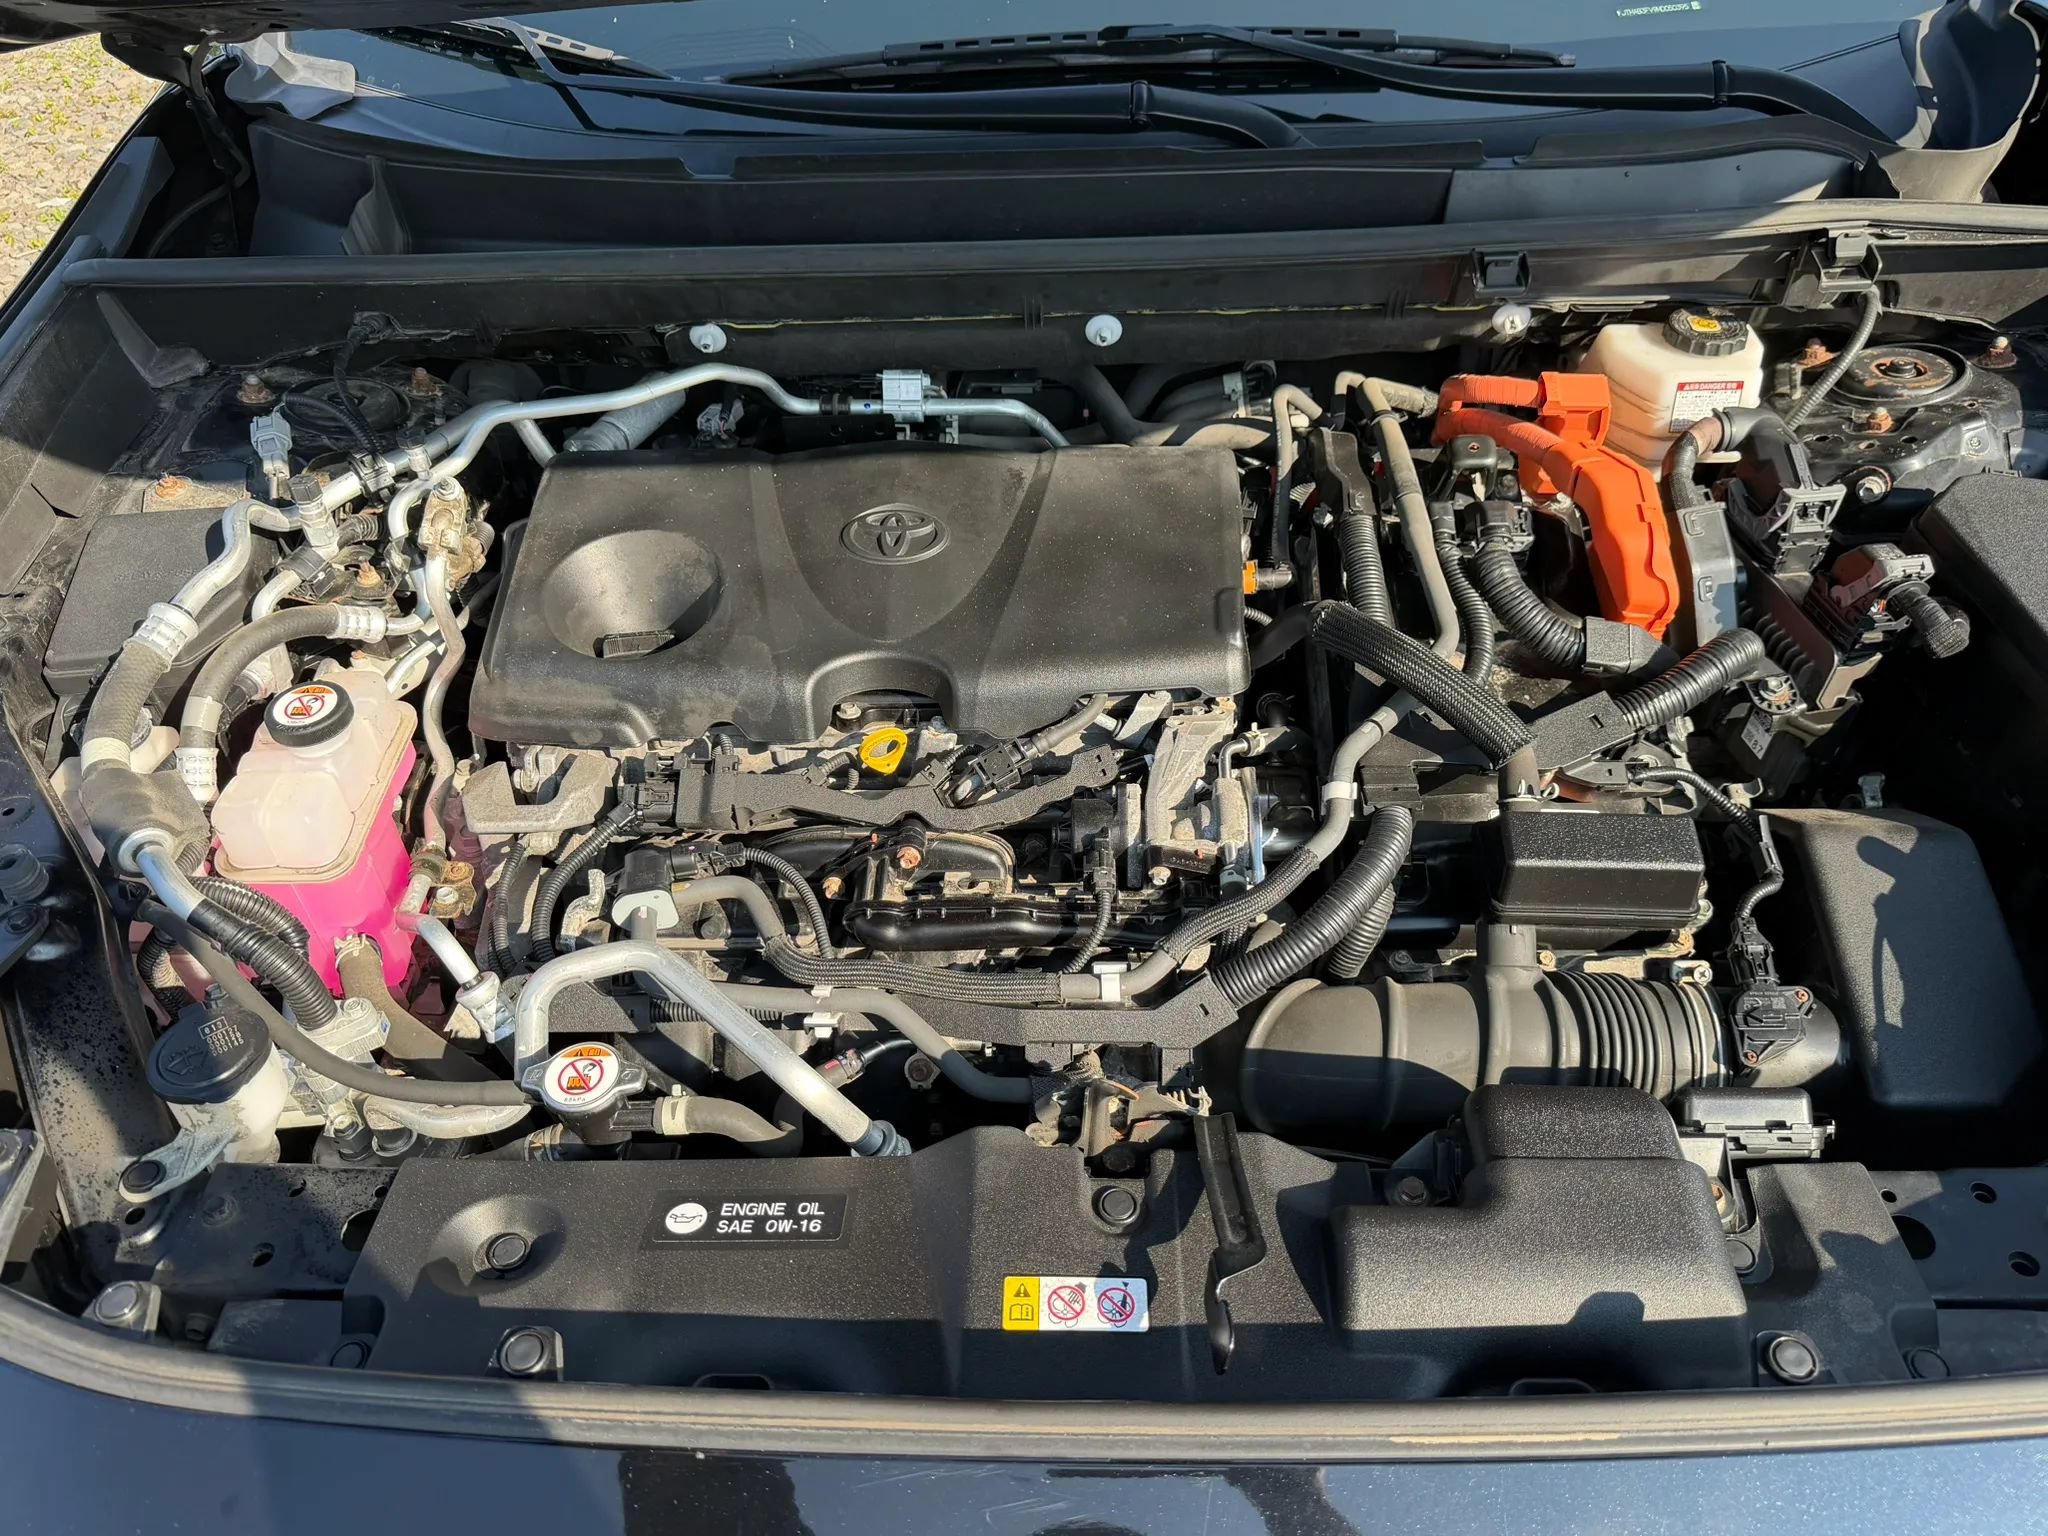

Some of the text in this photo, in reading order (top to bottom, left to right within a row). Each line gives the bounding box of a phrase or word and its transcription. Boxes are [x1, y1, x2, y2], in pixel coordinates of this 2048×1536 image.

[720, 1202, 825, 1216] ENGINE OIL
[716, 1219, 822, 1233] SAE 0W-16
